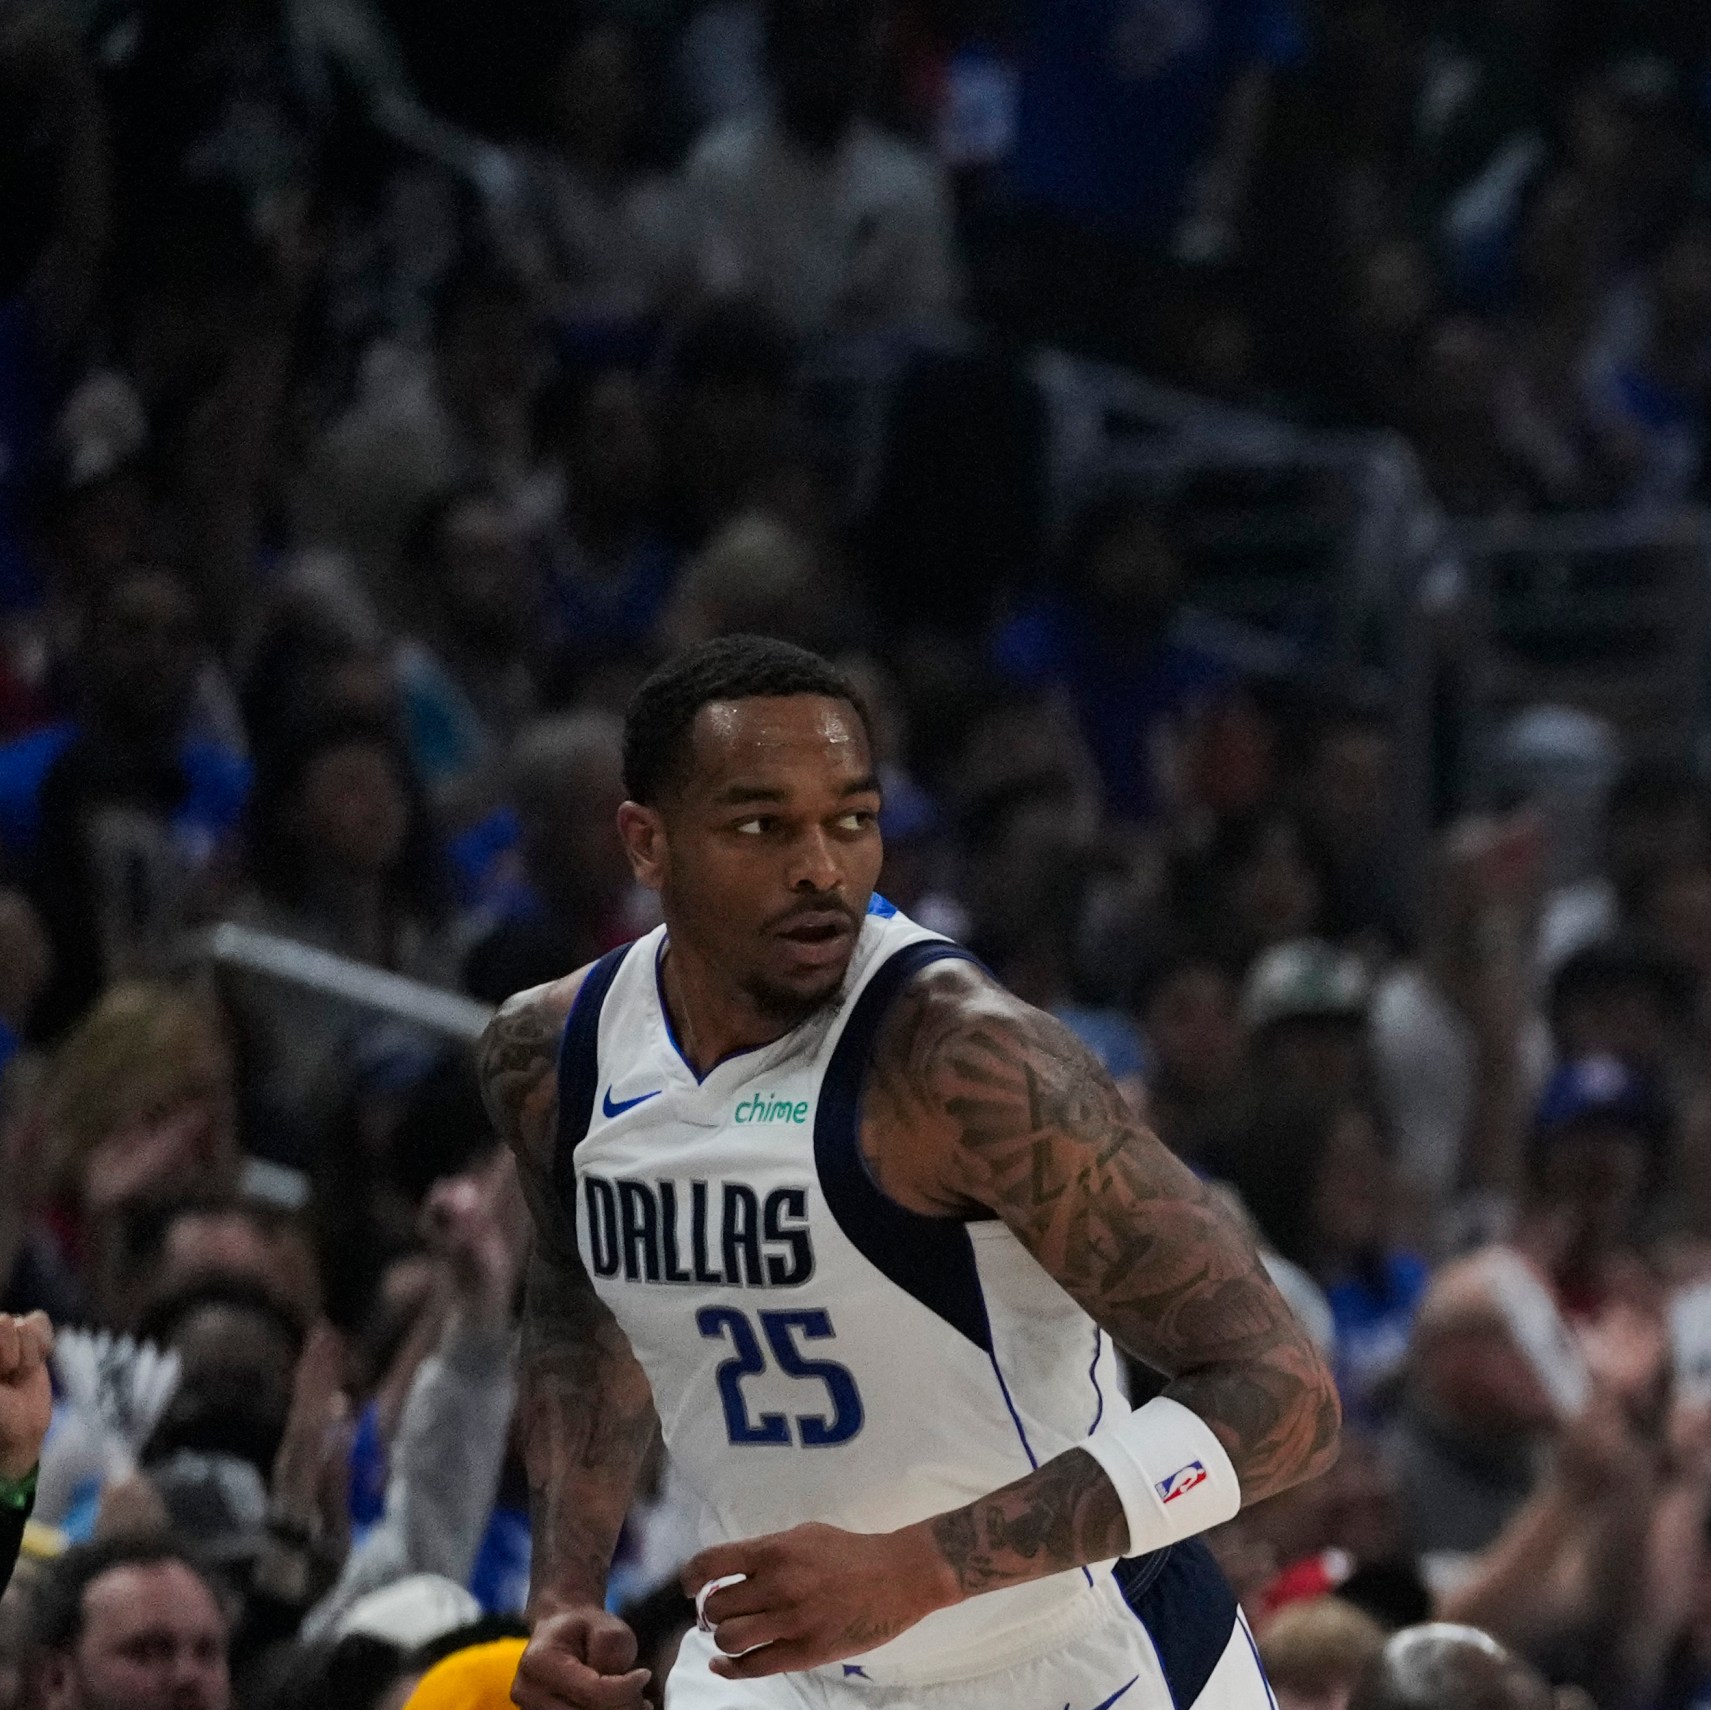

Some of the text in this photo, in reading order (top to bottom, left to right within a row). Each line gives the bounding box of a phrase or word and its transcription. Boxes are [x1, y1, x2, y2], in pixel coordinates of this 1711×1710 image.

[735, 1092, 808, 1123] chime
[583, 1174, 817, 1289] DALLAS
[695, 1304, 865, 1448] 25
